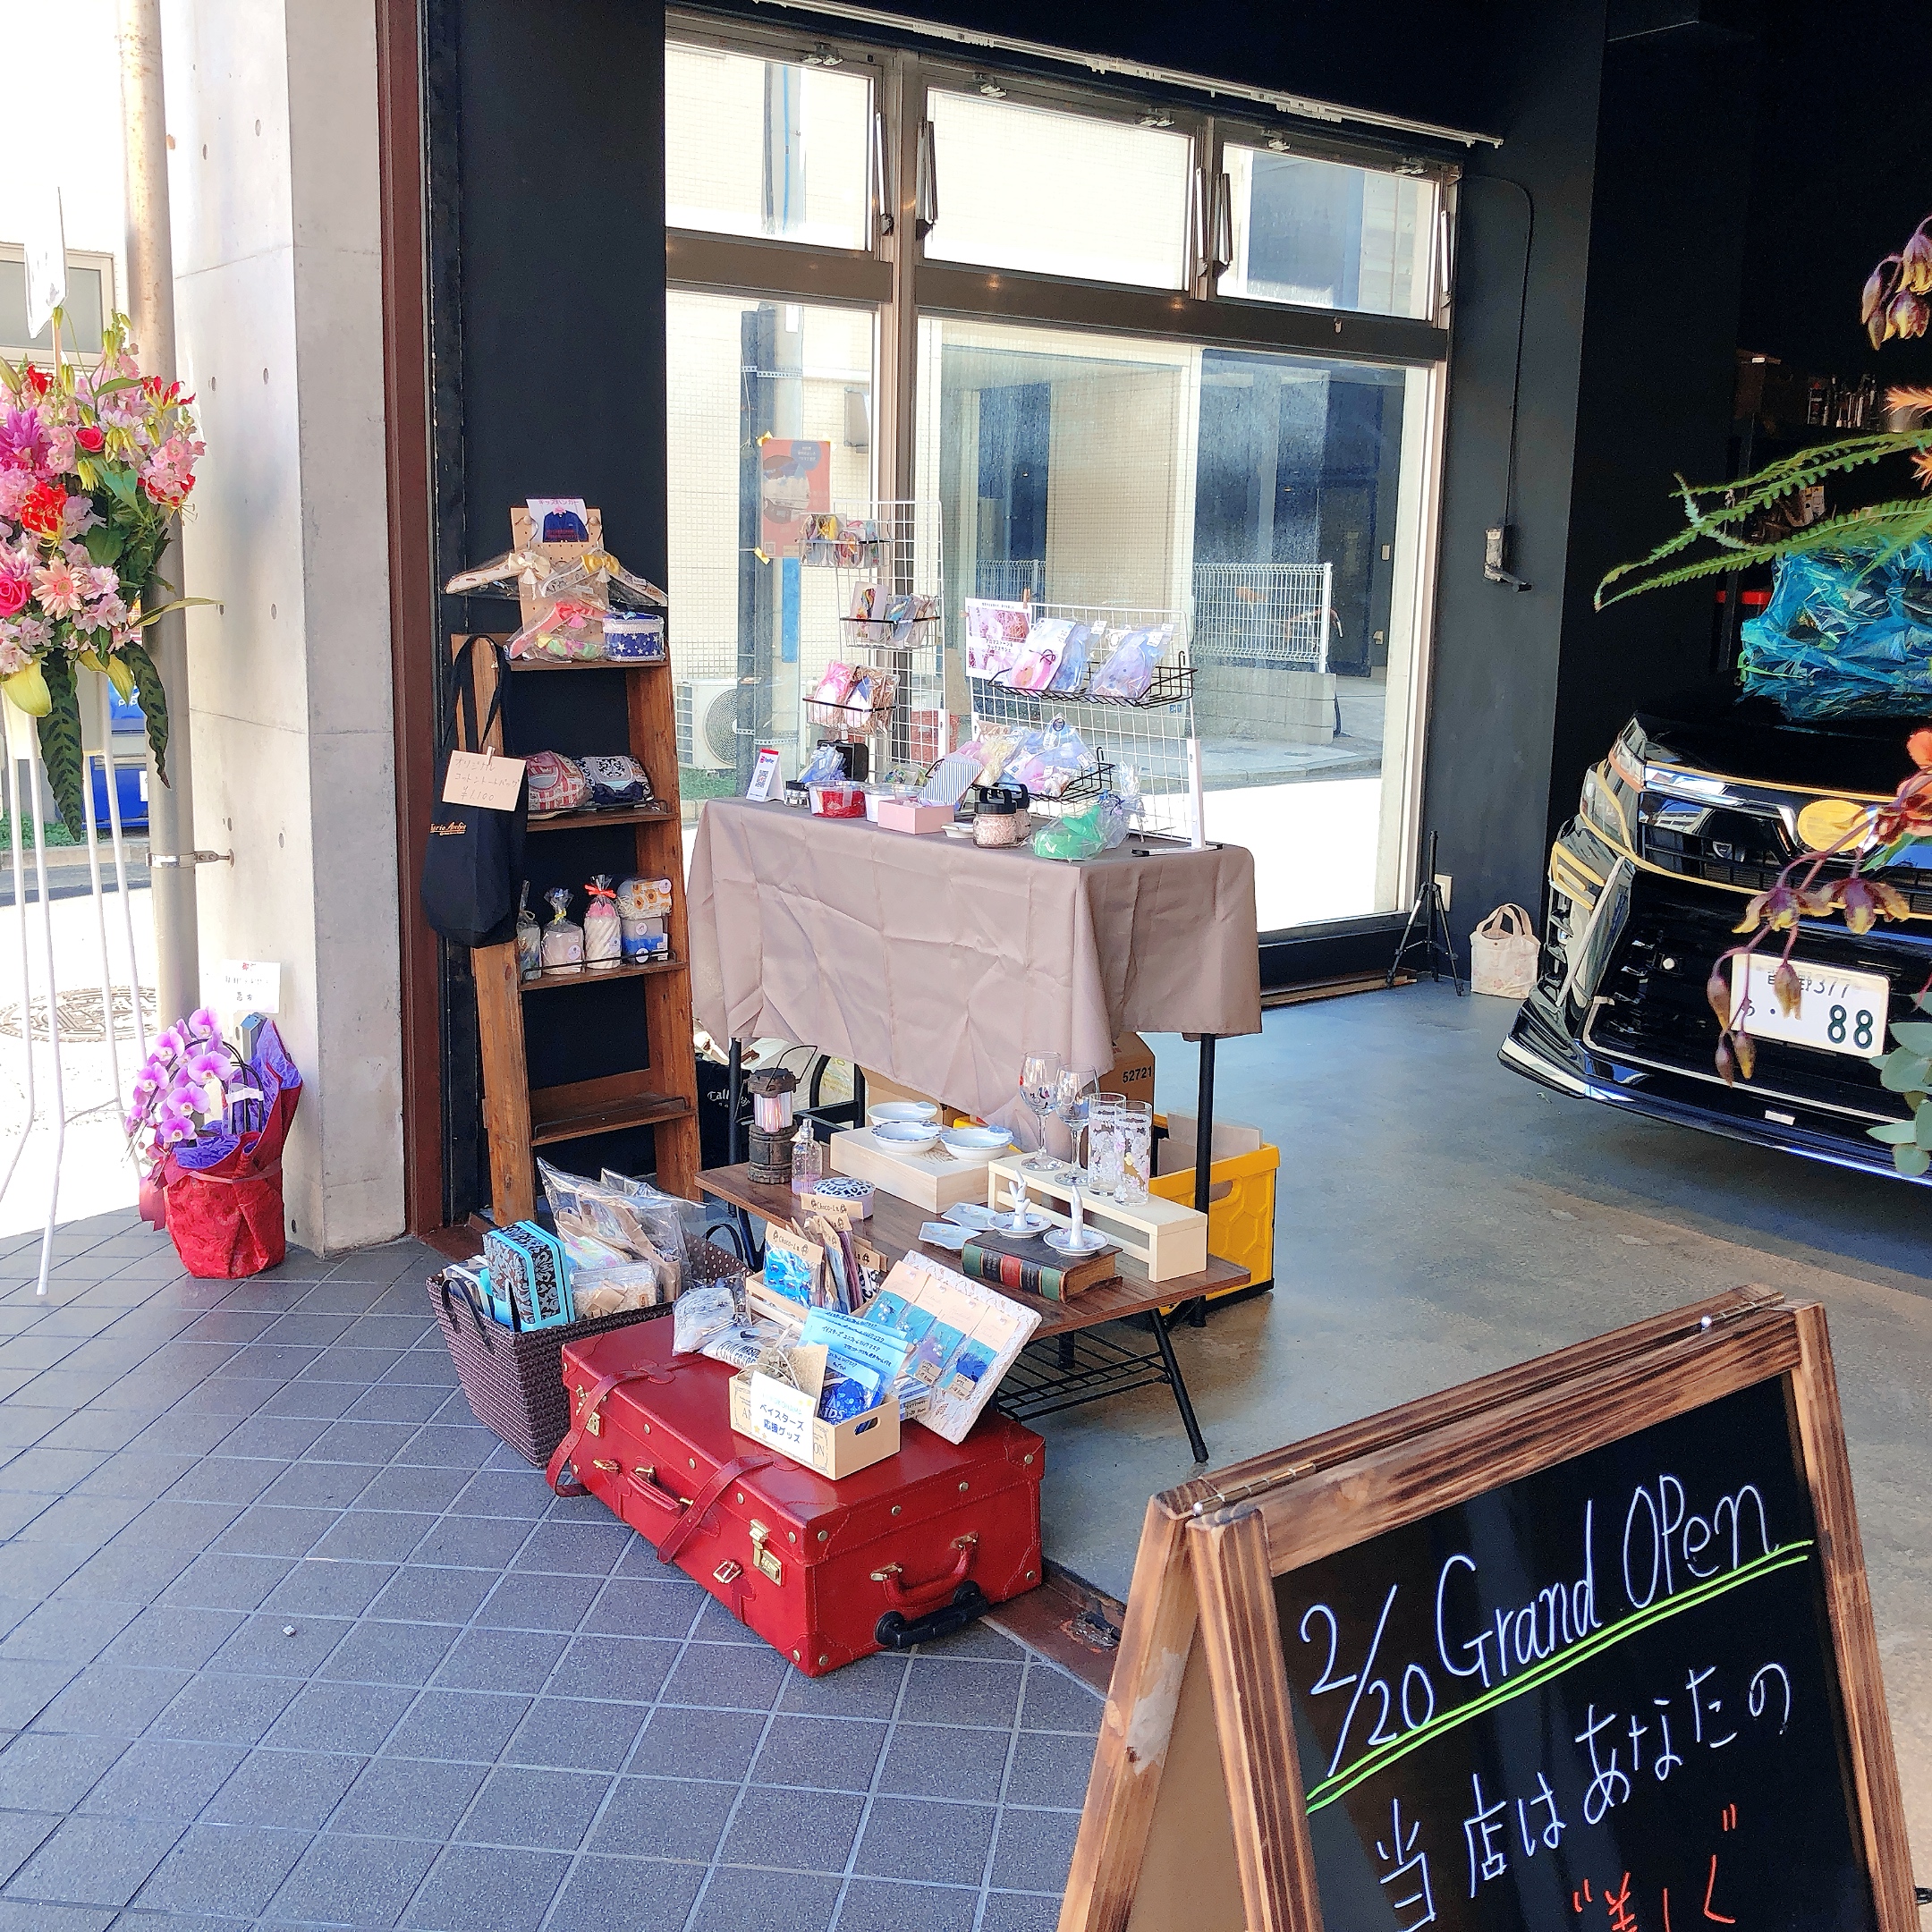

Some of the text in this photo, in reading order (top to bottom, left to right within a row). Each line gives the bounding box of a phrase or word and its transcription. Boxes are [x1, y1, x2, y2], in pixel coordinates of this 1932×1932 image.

[1122, 1065, 1152, 1083] 52721
[1300, 1582, 1436, 1778] 2/20
[1435, 1498, 1603, 1689] Grand
[1376, 1662, 1791, 1932] 当店はあなたの
